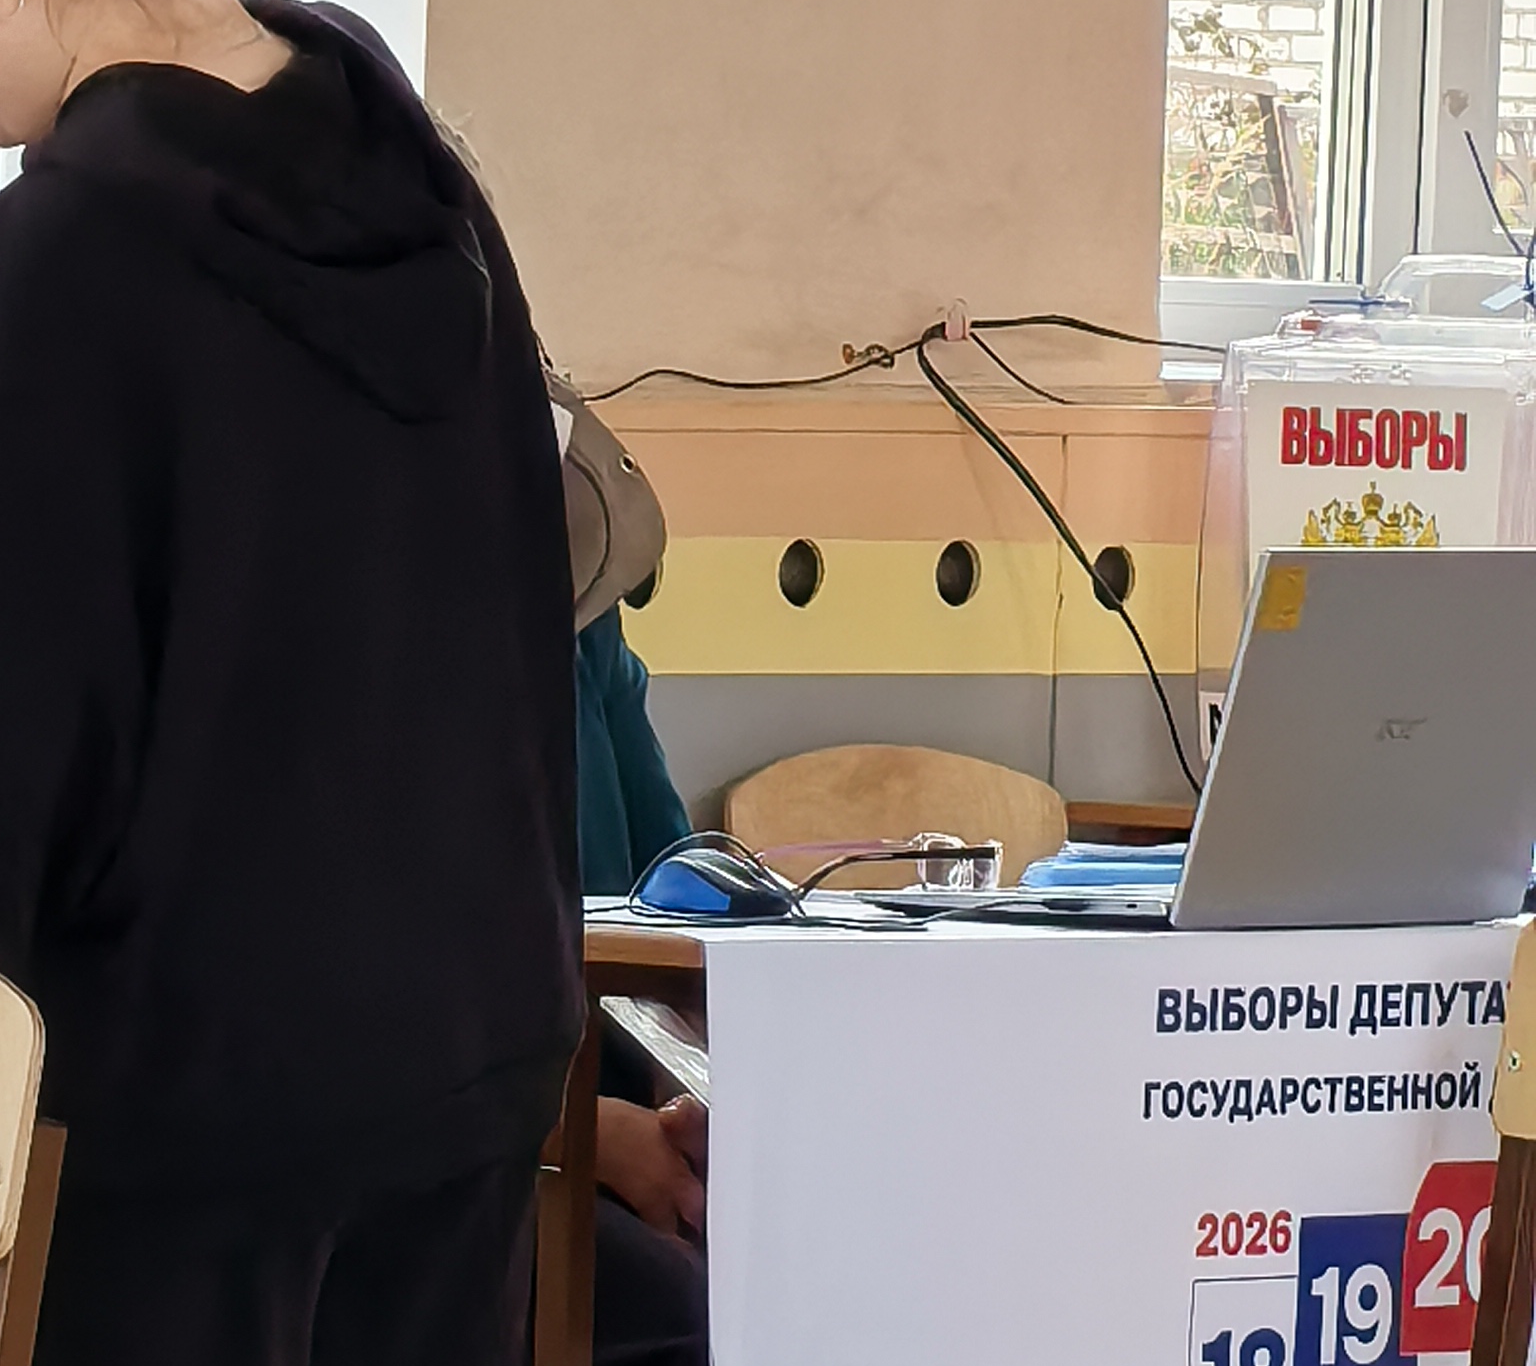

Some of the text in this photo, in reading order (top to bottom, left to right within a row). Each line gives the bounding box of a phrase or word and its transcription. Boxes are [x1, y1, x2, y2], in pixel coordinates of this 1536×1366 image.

[1281, 407, 1466, 471] ВЫБОРЫ
[1157, 981, 1510, 1034] ВЫБОРЫ ДЕПУТА
[1144, 1062, 1480, 1123] ГОСУДАРСТВЕННОЙ
[1196, 1210, 1291, 1257] 2026
[1311, 1264, 1392, 1365] 19
